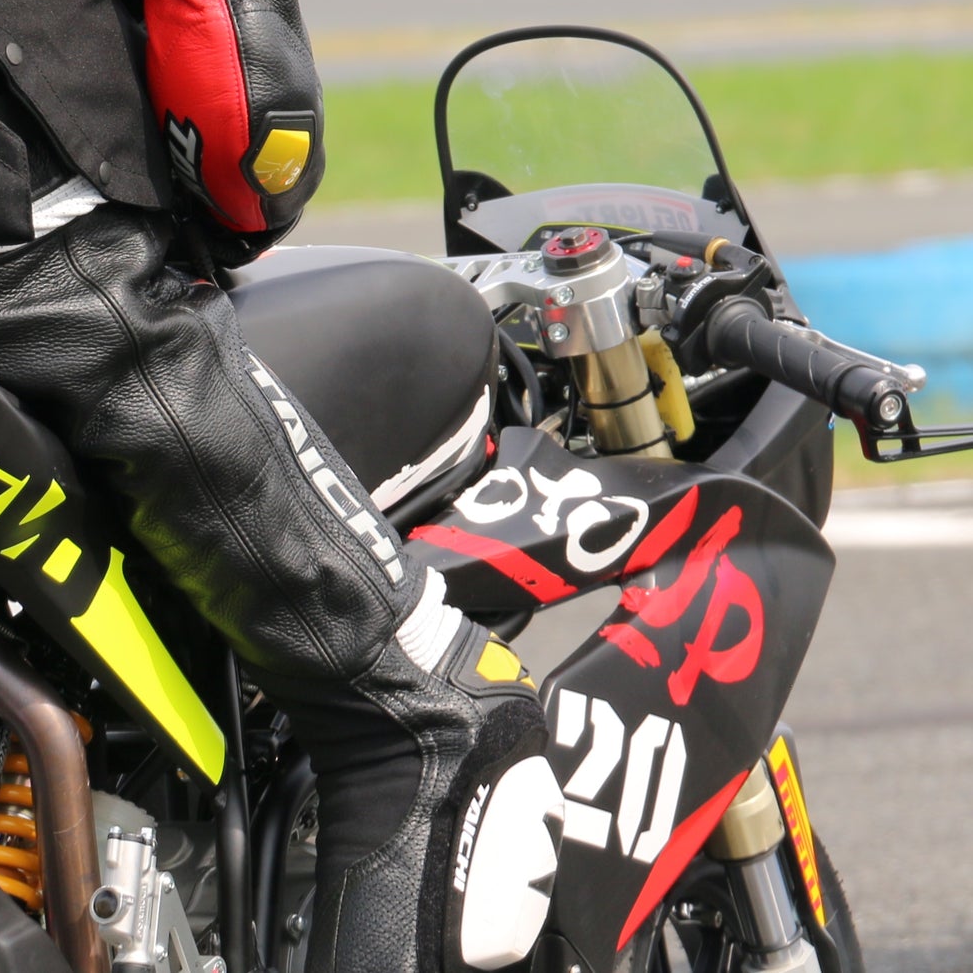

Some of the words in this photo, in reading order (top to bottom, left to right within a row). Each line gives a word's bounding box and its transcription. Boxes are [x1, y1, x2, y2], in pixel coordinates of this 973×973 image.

[680, 276, 713, 309] domino
[248, 353, 404, 583] TAICHI
[453, 784, 490, 893] TAICHI
[555, 688, 687, 864] 20
[774, 758, 821, 911] PIRELLI
